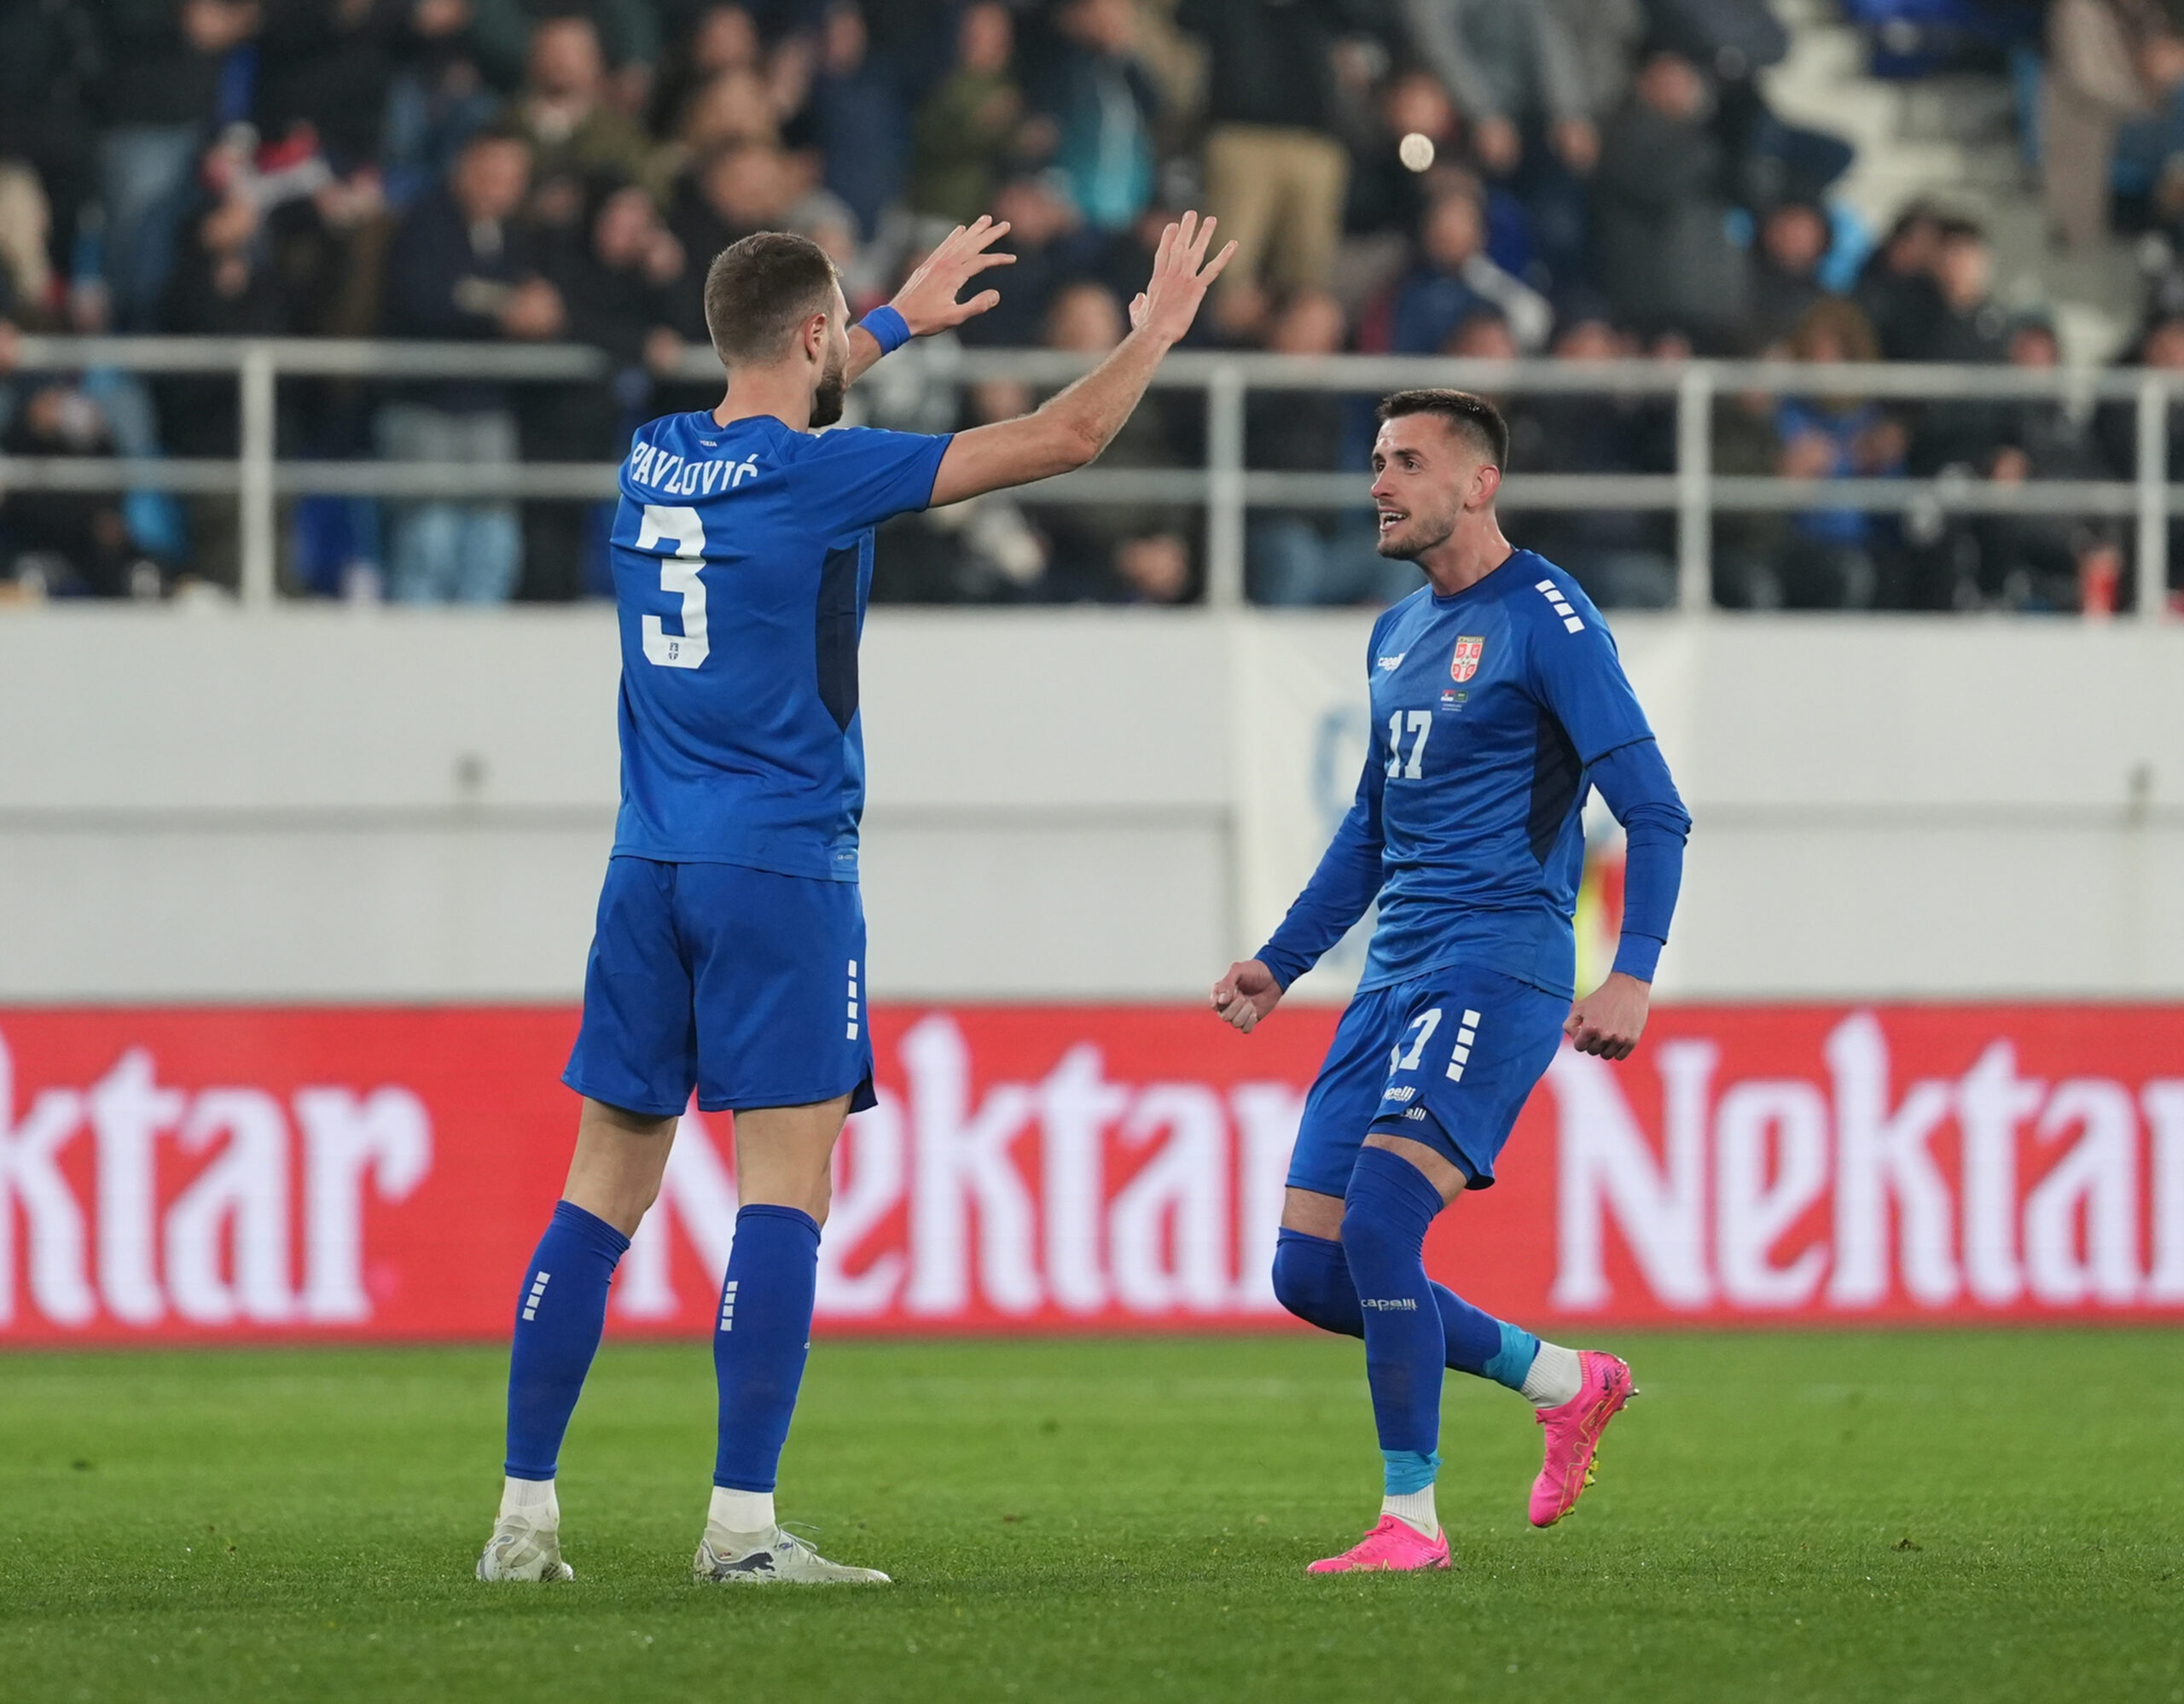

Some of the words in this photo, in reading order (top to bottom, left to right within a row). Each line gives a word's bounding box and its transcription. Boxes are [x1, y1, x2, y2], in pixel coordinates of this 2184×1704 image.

[631, 441, 758, 495] PAVLOVIĆ
[636, 504, 710, 669] 3
[1388, 710, 1432, 780] 17
[1361, 1298, 1417, 1311] capelli
